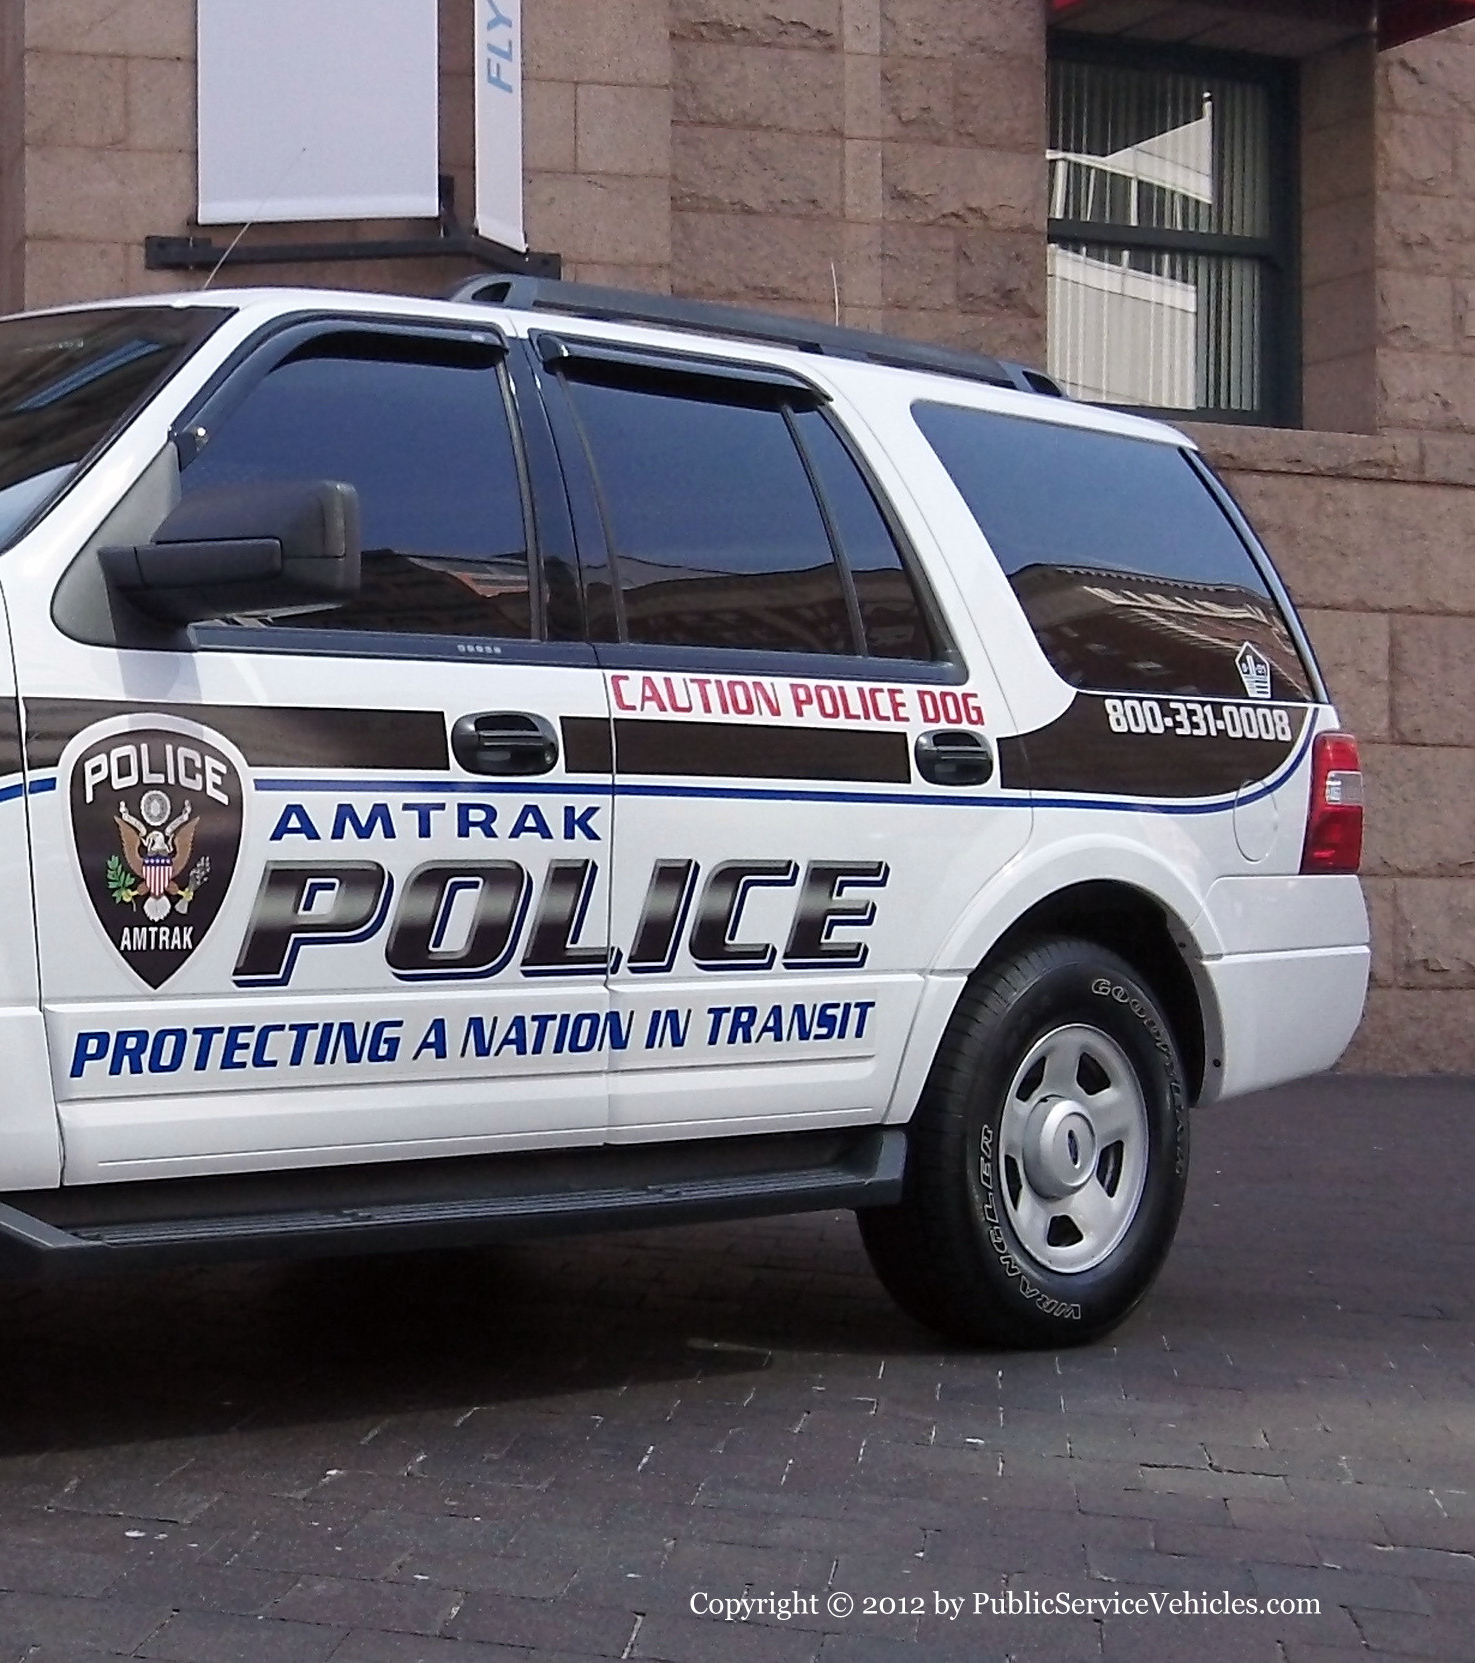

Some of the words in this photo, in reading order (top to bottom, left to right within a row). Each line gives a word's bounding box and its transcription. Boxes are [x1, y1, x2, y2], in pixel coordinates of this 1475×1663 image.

[487, 0, 513, 94] FLY
[610, 674, 782, 716] CAUTION
[789, 683, 910, 722] POLICE
[916, 690, 985, 726] DOG
[1104, 698, 1292, 742] 800-331-0008
[83, 744, 229, 805] POLICE
[269, 801, 603, 841] AMTRAK
[120, 926, 194, 951] AMTRAK
[231, 858, 890, 988] POLICE
[69, 1019, 404, 1078] PROTECTING
[412, 1018, 447, 1060] A
[460, 1010, 634, 1058] NATION
[645, 1009, 692, 1049] IN
[706, 1001, 876, 1046] TRANSIT
[979, 1124, 1082, 1320] WRANGLER
